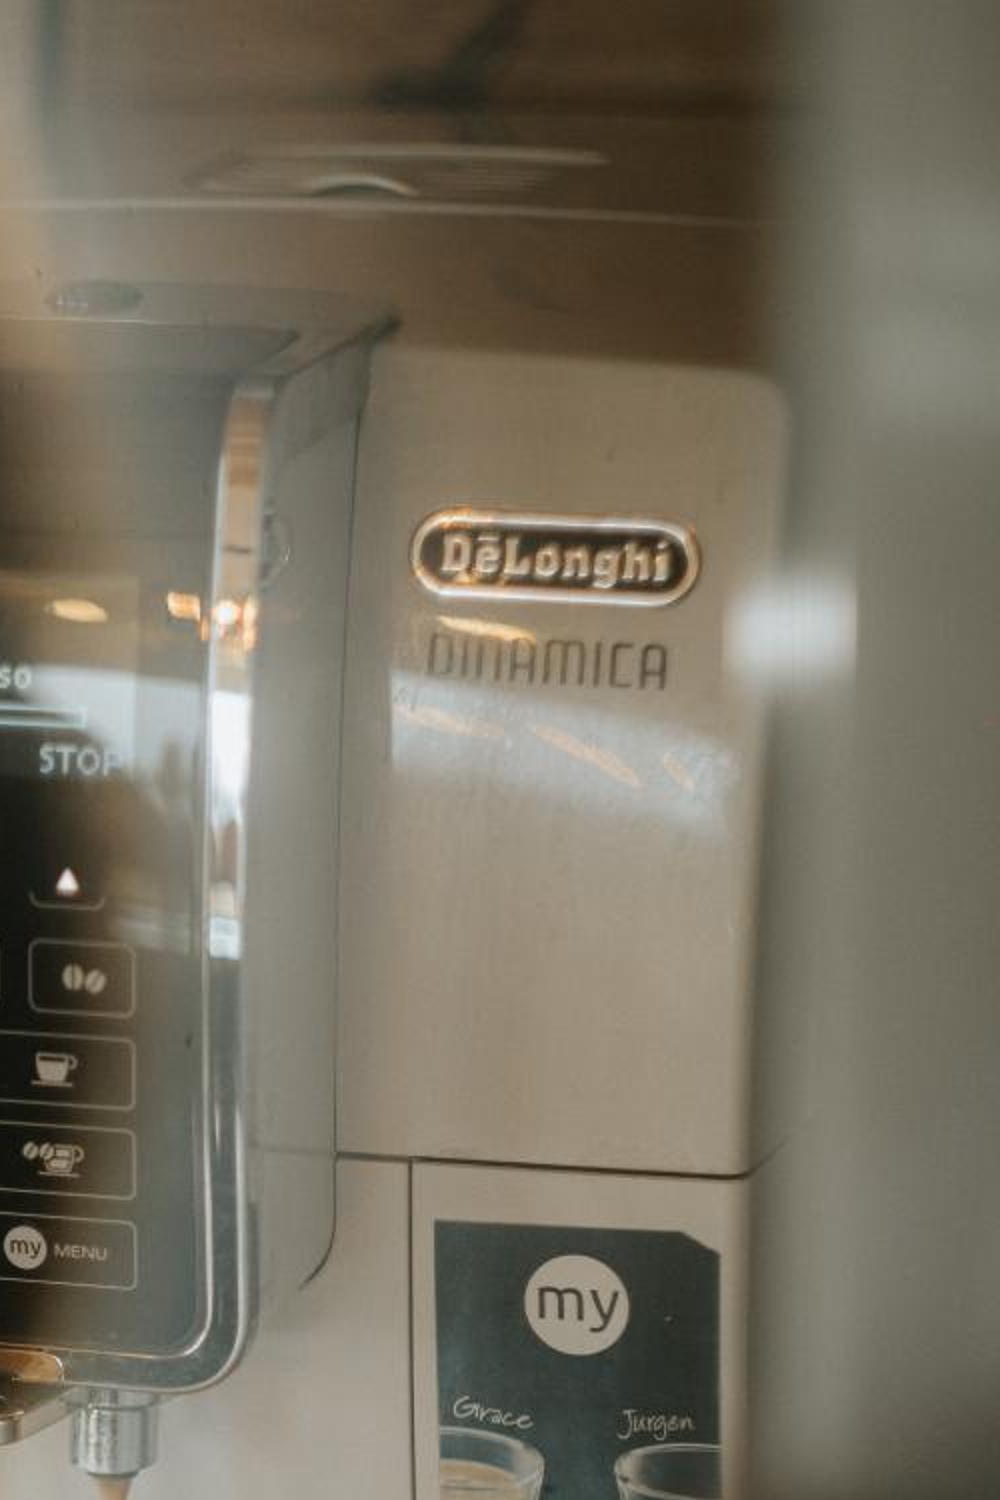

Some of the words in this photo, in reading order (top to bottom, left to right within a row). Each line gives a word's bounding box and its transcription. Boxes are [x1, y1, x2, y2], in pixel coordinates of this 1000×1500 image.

[426, 632, 669, 692] DINAMICA
[9, 1237, 43, 1259] my
[53, 1242, 108, 1262] MENU
[536, 1284, 620, 1333] my
[453, 1395, 535, 1430] Grace
